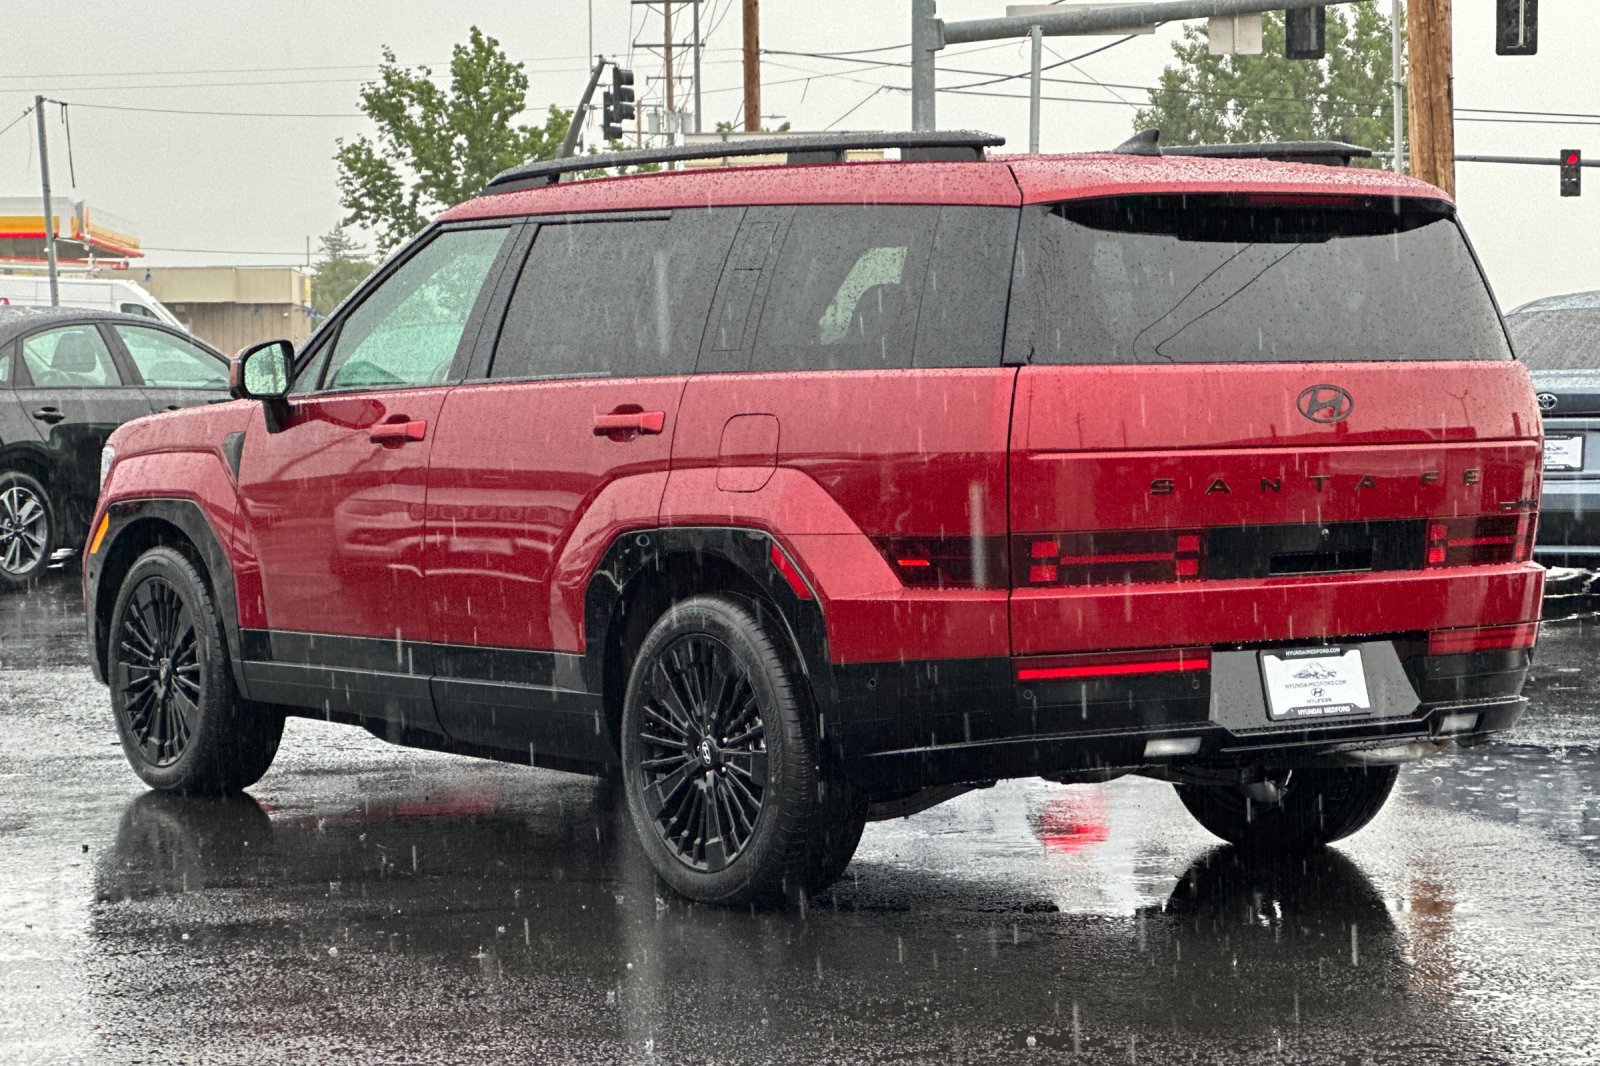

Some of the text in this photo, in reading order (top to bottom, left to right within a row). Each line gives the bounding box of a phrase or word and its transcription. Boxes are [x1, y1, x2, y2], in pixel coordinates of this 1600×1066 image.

[1150, 467, 1480, 496] SANTA FE
[1286, 648, 1340, 656] HYUNDAIMEDFORD.COM
[1285, 680, 1346, 688] HYUNDAIMEDFORD.COM
